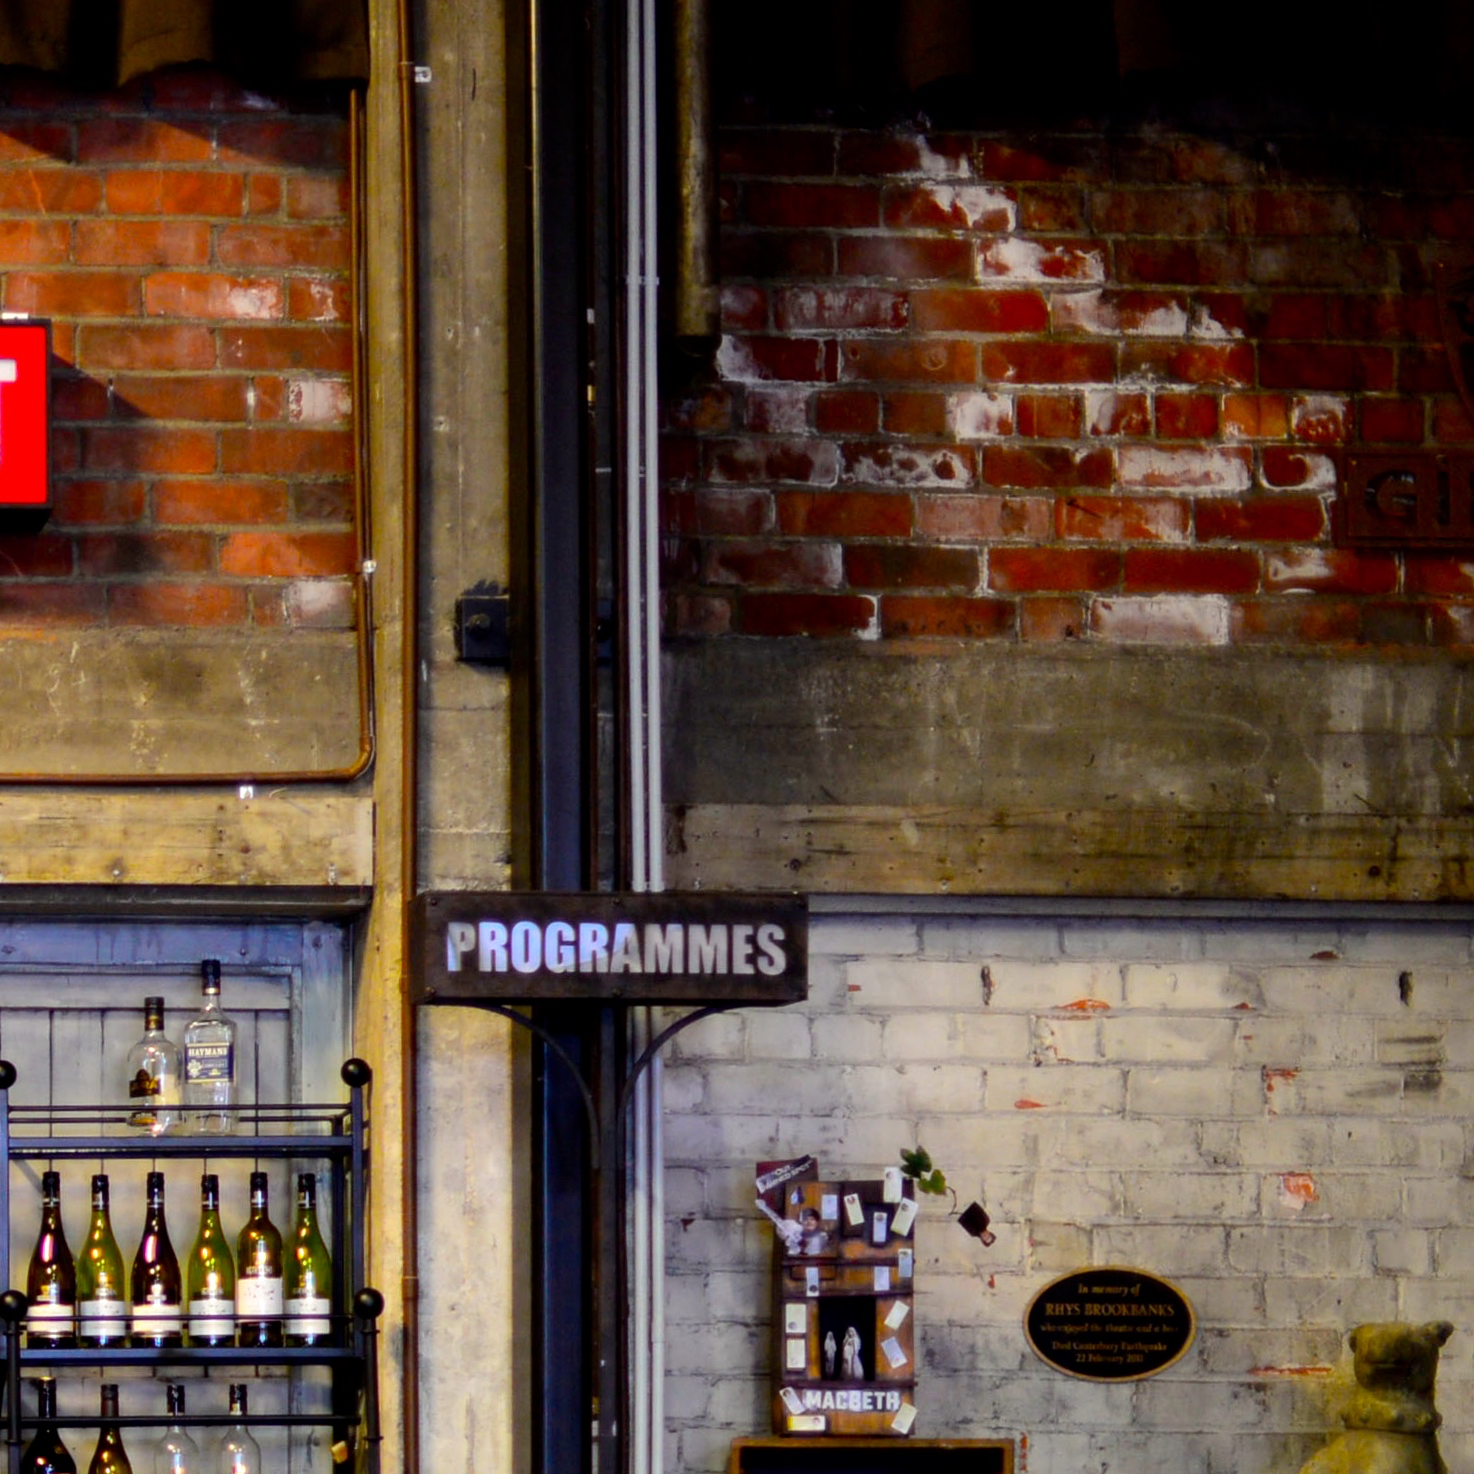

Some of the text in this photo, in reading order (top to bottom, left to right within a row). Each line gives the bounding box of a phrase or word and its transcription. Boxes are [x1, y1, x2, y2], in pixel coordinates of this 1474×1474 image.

[447, 920, 788, 977] PROGRAMMES
[1045, 1303, 1175, 1316] RHYS BROOKBANKS
[805, 1390, 900, 1410] MACBETH
